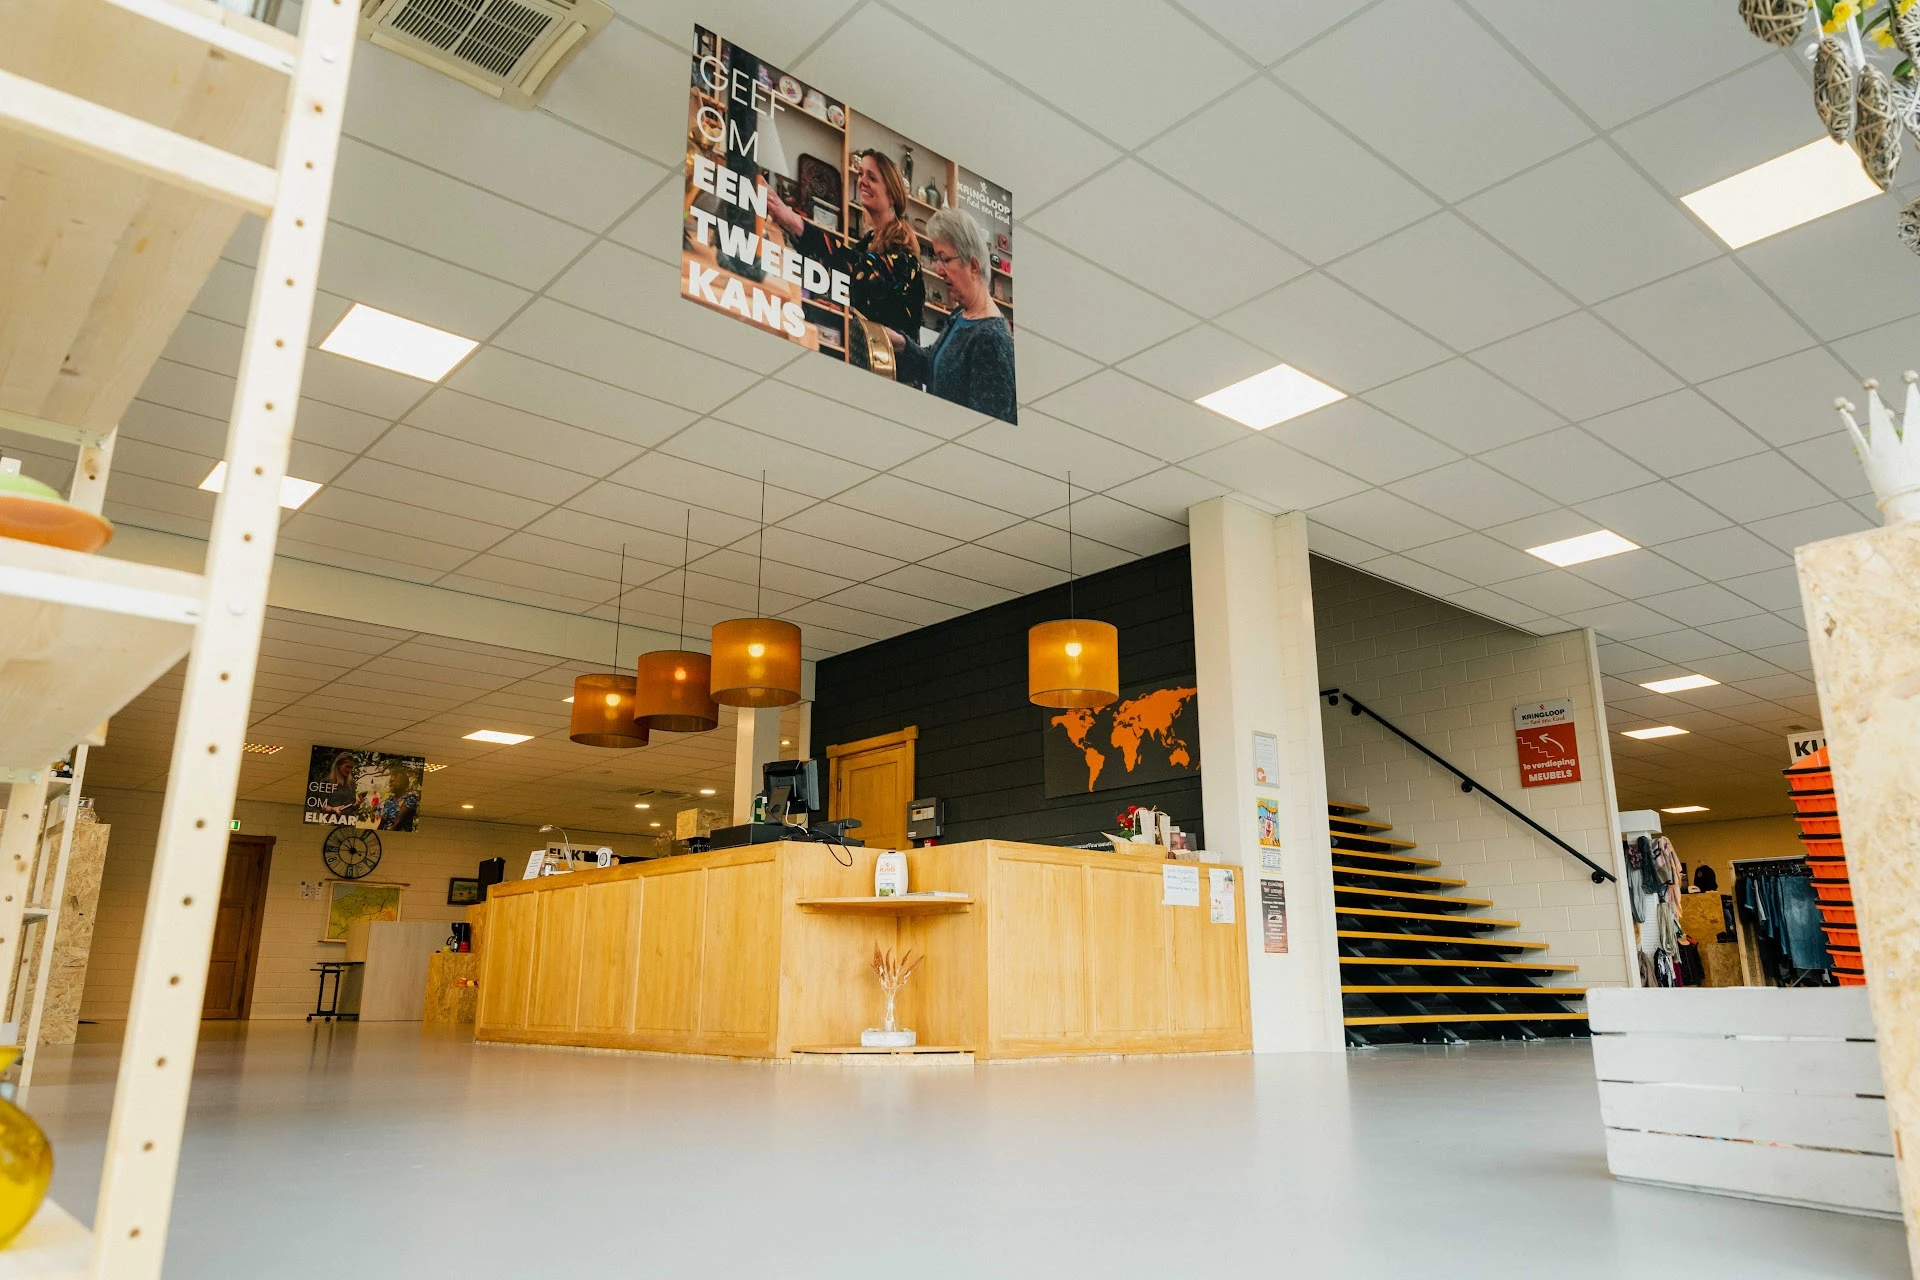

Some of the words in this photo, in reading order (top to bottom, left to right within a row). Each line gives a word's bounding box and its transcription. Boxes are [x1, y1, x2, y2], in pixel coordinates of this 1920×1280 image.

[699, 55, 787, 119] GEEF
[697, 106, 758, 163] OM
[692, 153, 768, 219] EEN
[957, 181, 1011, 215] KRINGLOOP
[689, 205, 851, 307] TWEEDE
[689, 260, 806, 338] KANS
[1521, 708, 1565, 721] KRINGLOOP
[1528, 769, 1573, 782] MEUBELS
[1532, 757, 1576, 770] verdieping
[308, 781, 339, 794] GEEF
[306, 796, 329, 808] OM
[304, 811, 357, 826] ELKAAR
